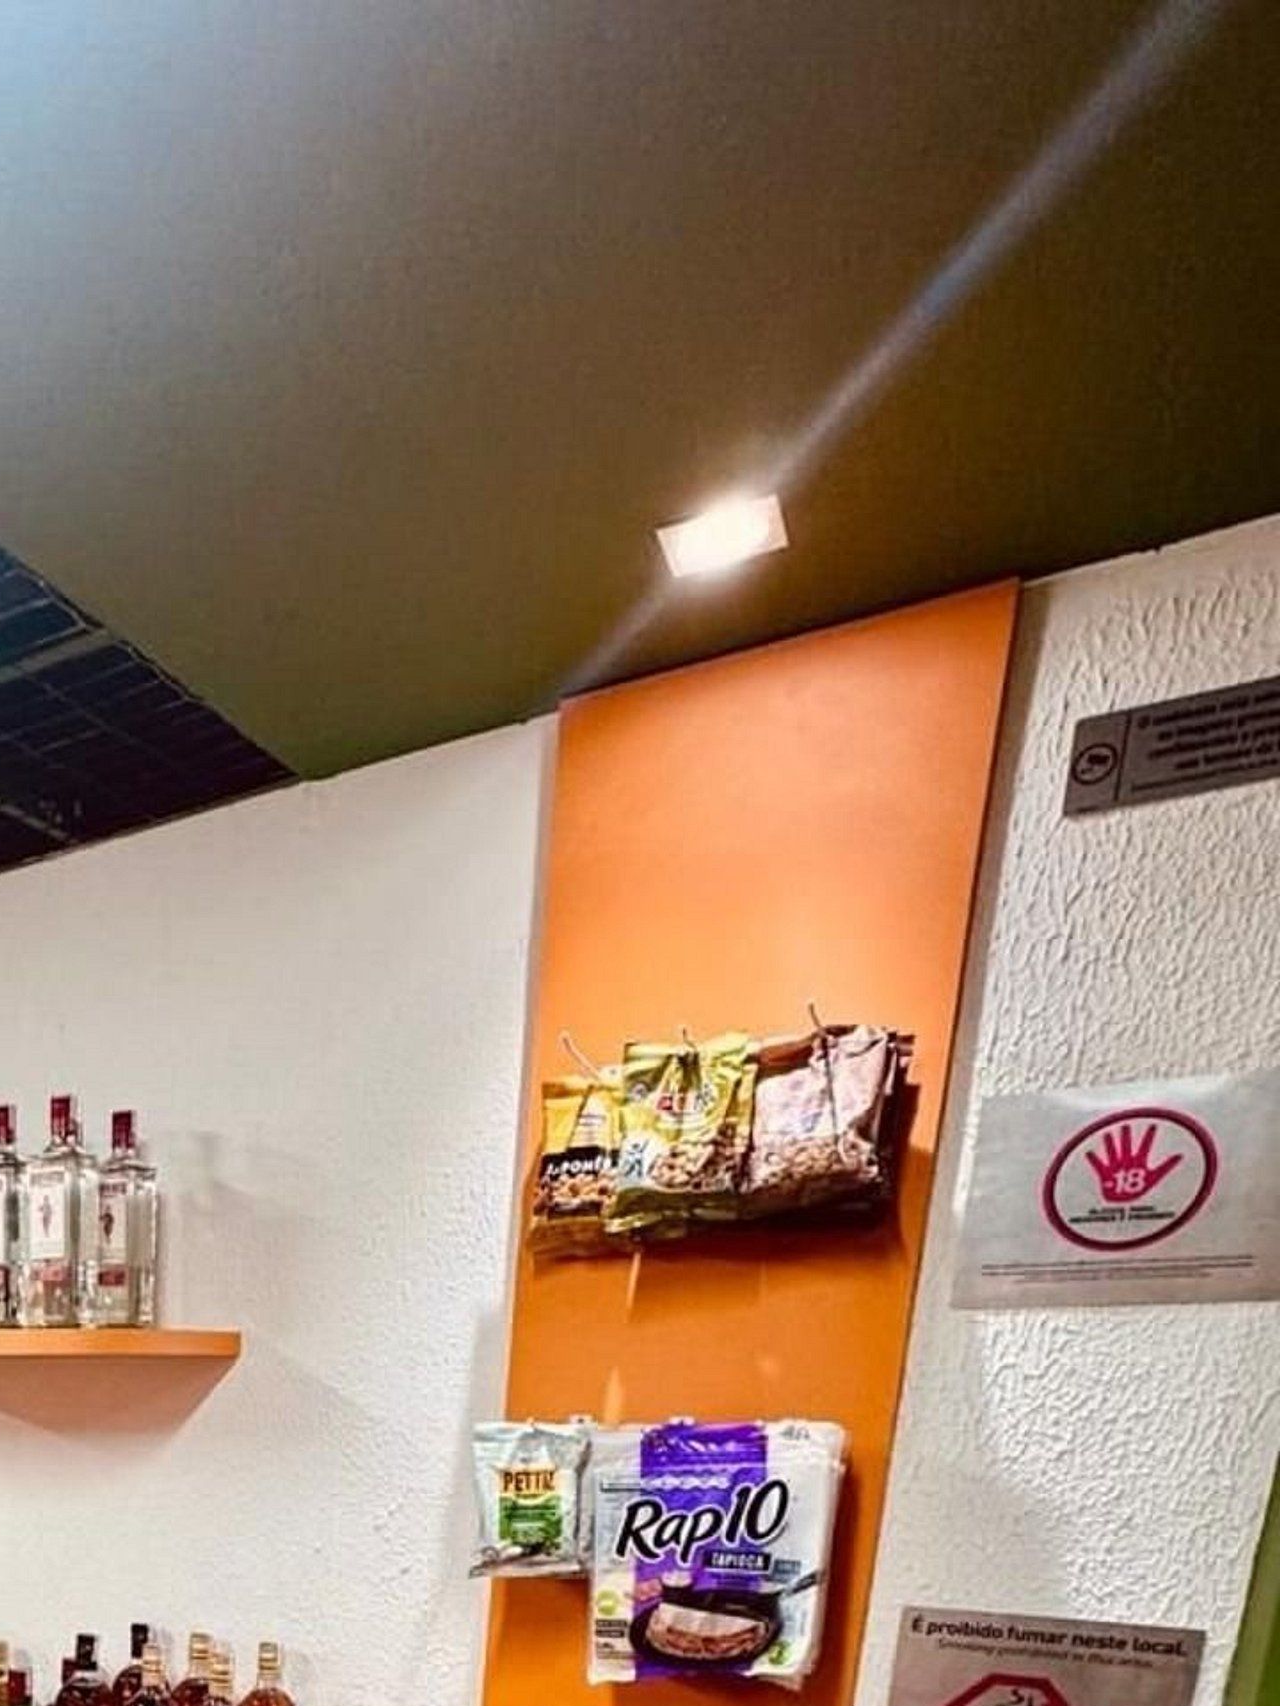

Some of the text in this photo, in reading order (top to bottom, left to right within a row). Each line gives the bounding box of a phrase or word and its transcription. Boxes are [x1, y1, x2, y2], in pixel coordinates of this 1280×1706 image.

[616, 1480, 788, 1563] Rap10
[926, 1621, 1003, 1641] proibido
[1007, 1626, 1067, 1645] fumar
[1071, 1633, 1127, 1651] neste
